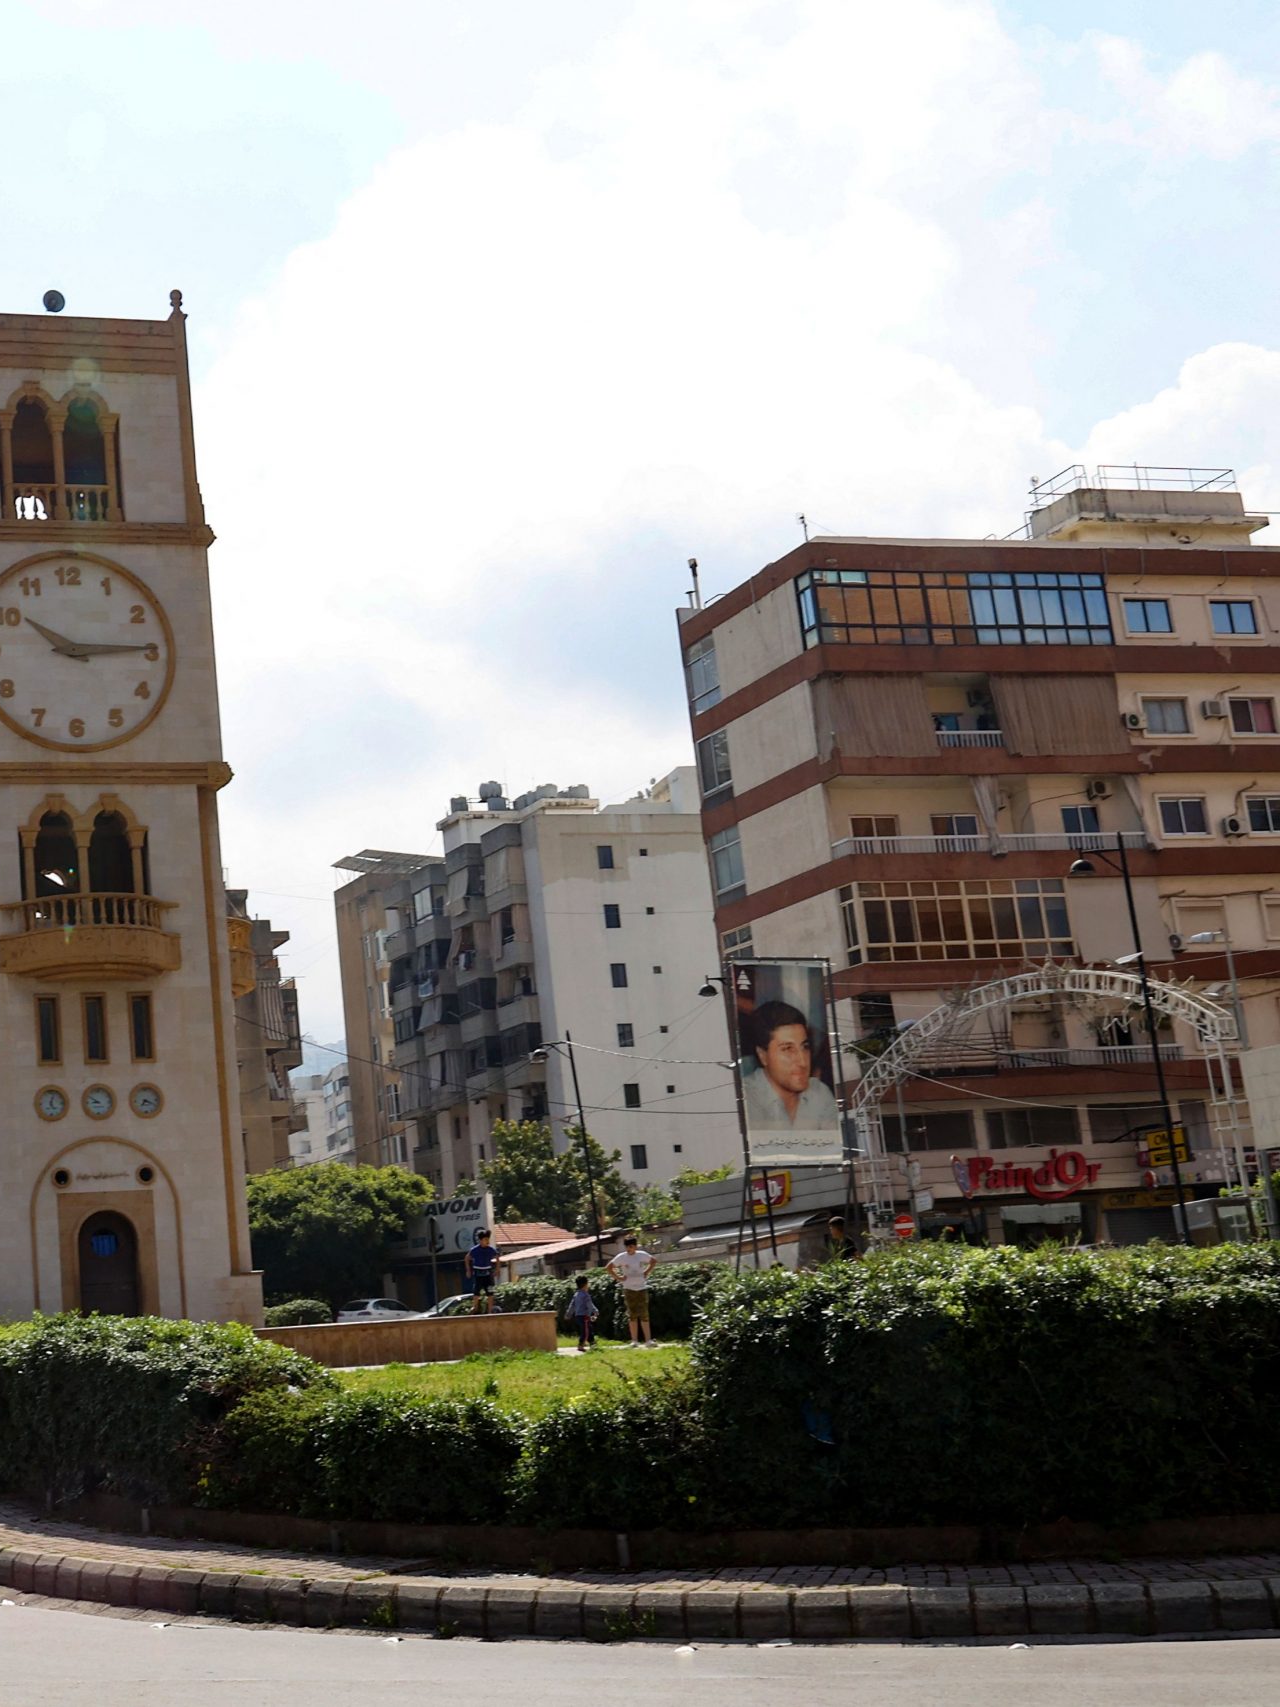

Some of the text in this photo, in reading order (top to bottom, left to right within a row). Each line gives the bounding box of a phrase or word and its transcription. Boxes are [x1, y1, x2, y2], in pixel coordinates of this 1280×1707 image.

[54, 567, 81, 586] 12
[19, 577, 41, 596] 11
[100, 577, 112, 596] 1
[130, 605, 146, 624] 2
[144, 643, 159, 662] 3
[0, 679, 15, 698] 8
[134, 681, 150, 700] 4
[30, 708, 47, 727] 7
[108, 708, 124, 727] 5
[69, 718, 85, 738] 6
[425, 1197, 483, 1217] AVON
[456, 1213, 481, 1223] TYRES
